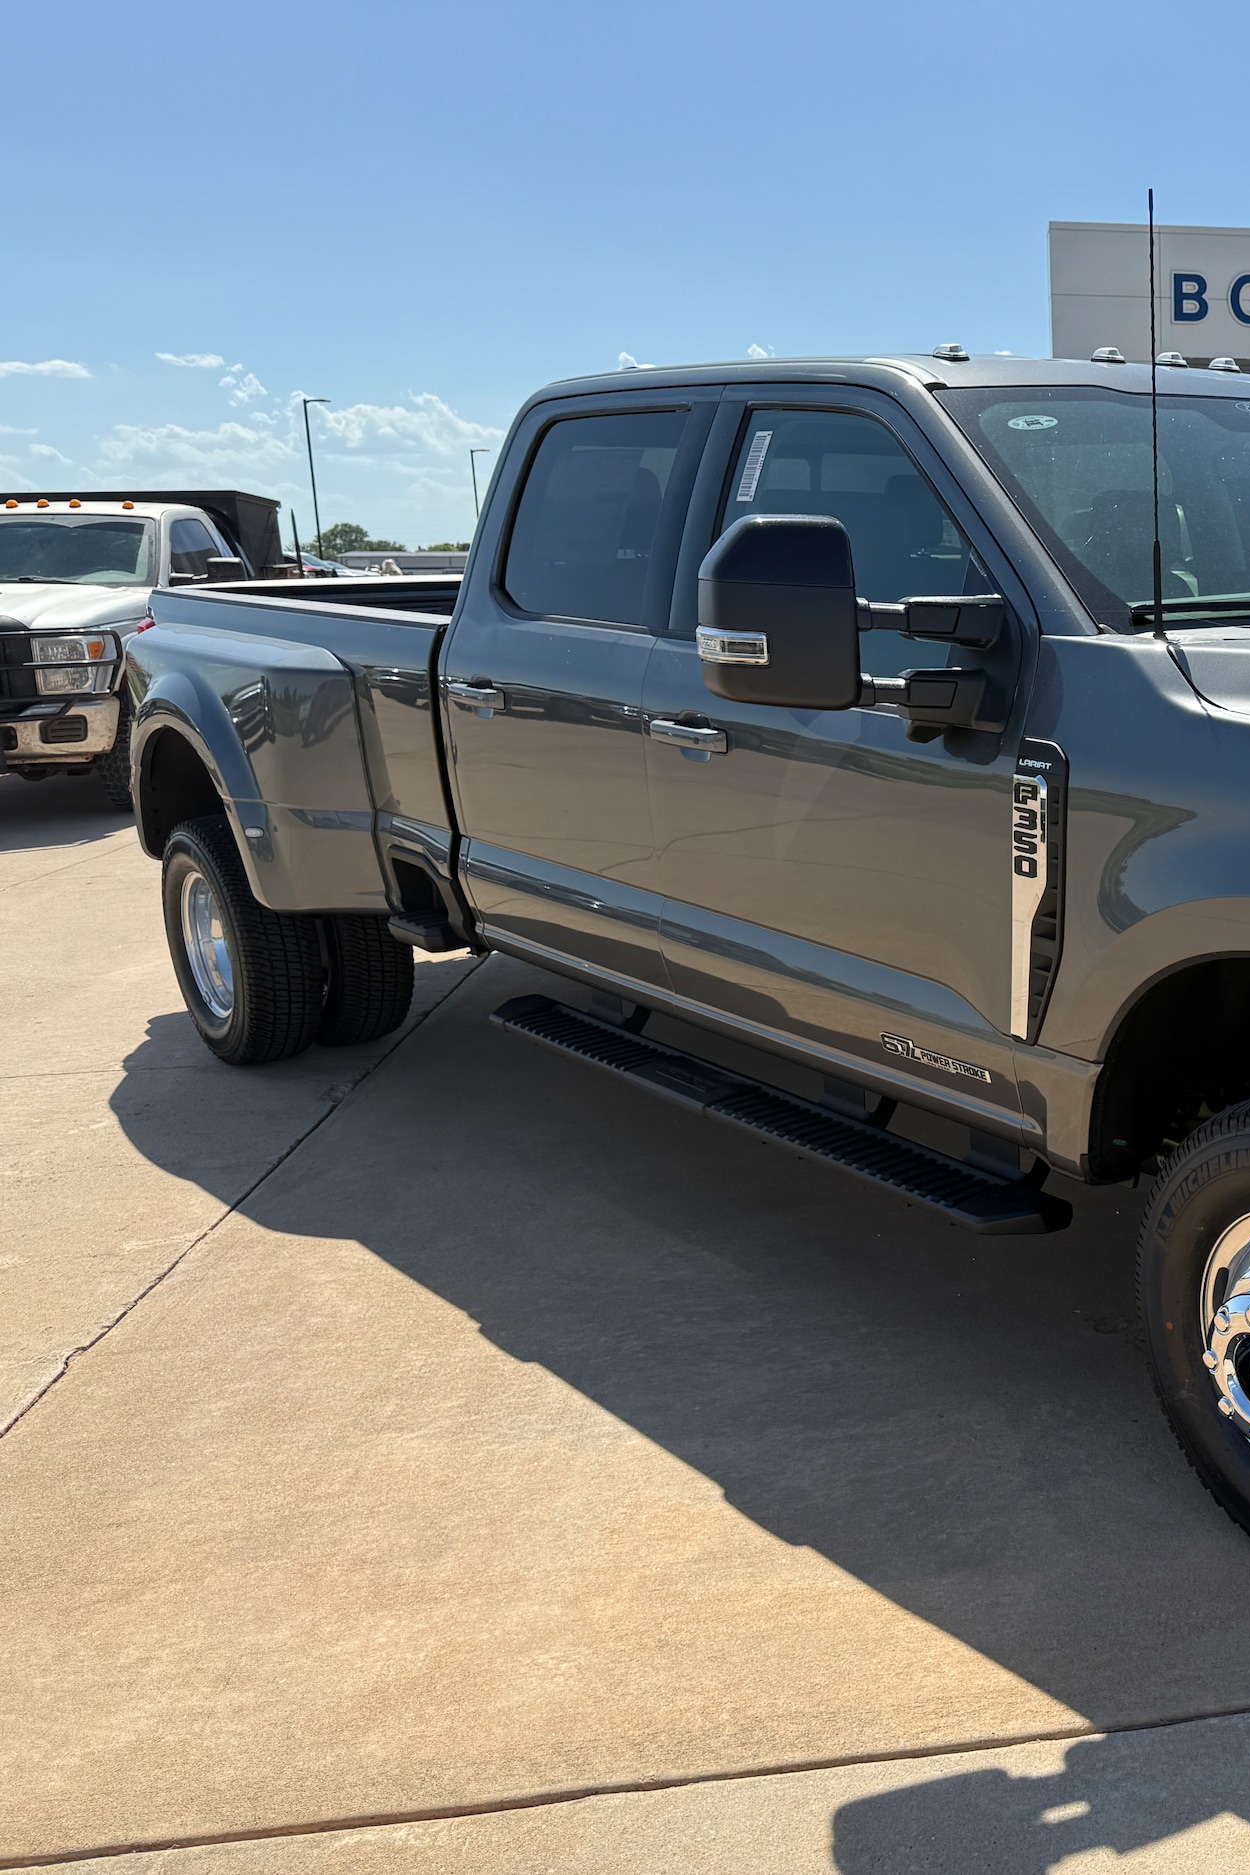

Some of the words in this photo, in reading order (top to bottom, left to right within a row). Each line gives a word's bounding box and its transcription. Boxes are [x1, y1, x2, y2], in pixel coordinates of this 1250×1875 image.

[1019, 758, 1052, 770] LARIAT
[1013, 782, 1038, 879] F350
[920, 1050, 951, 1069] POWER
[951, 1061, 987, 1080] STROKE
